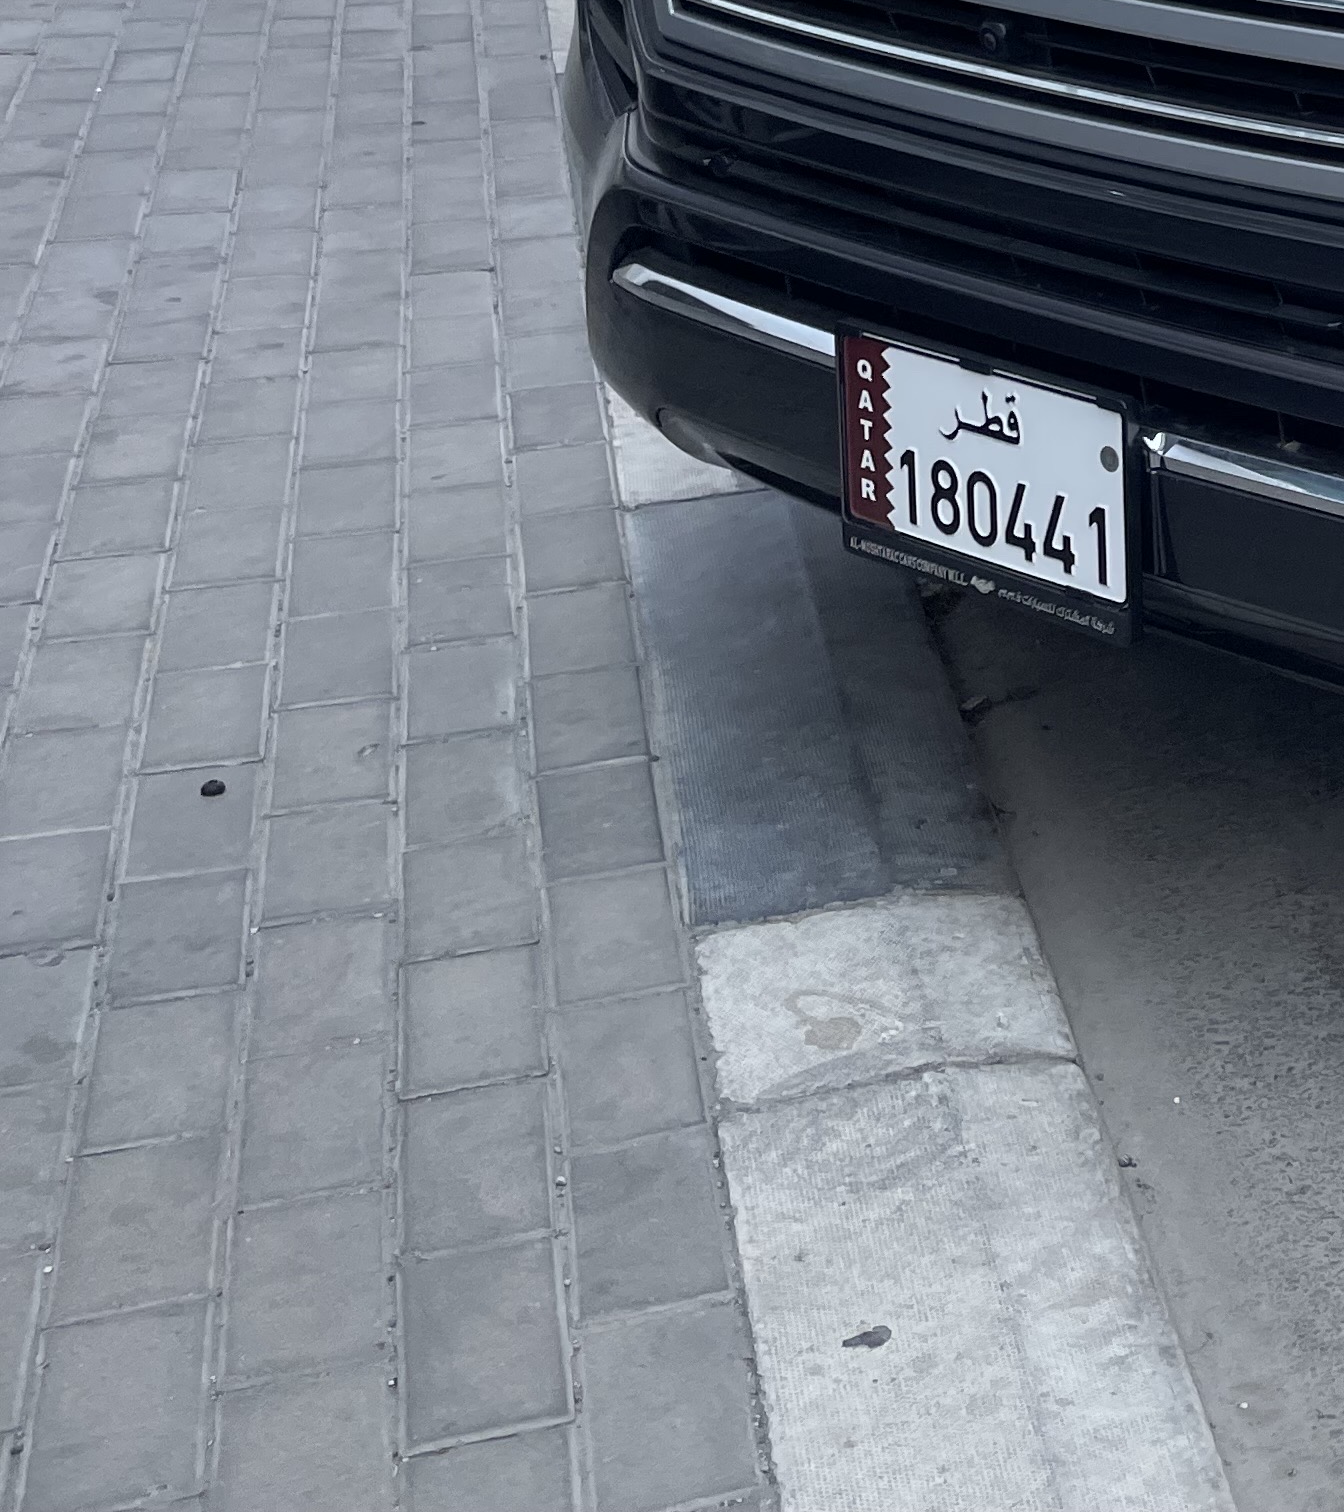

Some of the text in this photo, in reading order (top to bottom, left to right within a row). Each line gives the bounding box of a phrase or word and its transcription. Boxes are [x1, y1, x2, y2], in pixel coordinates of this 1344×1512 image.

[856, 358, 877, 502] QATAR
[938, 387, 1022, 446] قطر
[899, 447, 1110, 588] 180441
